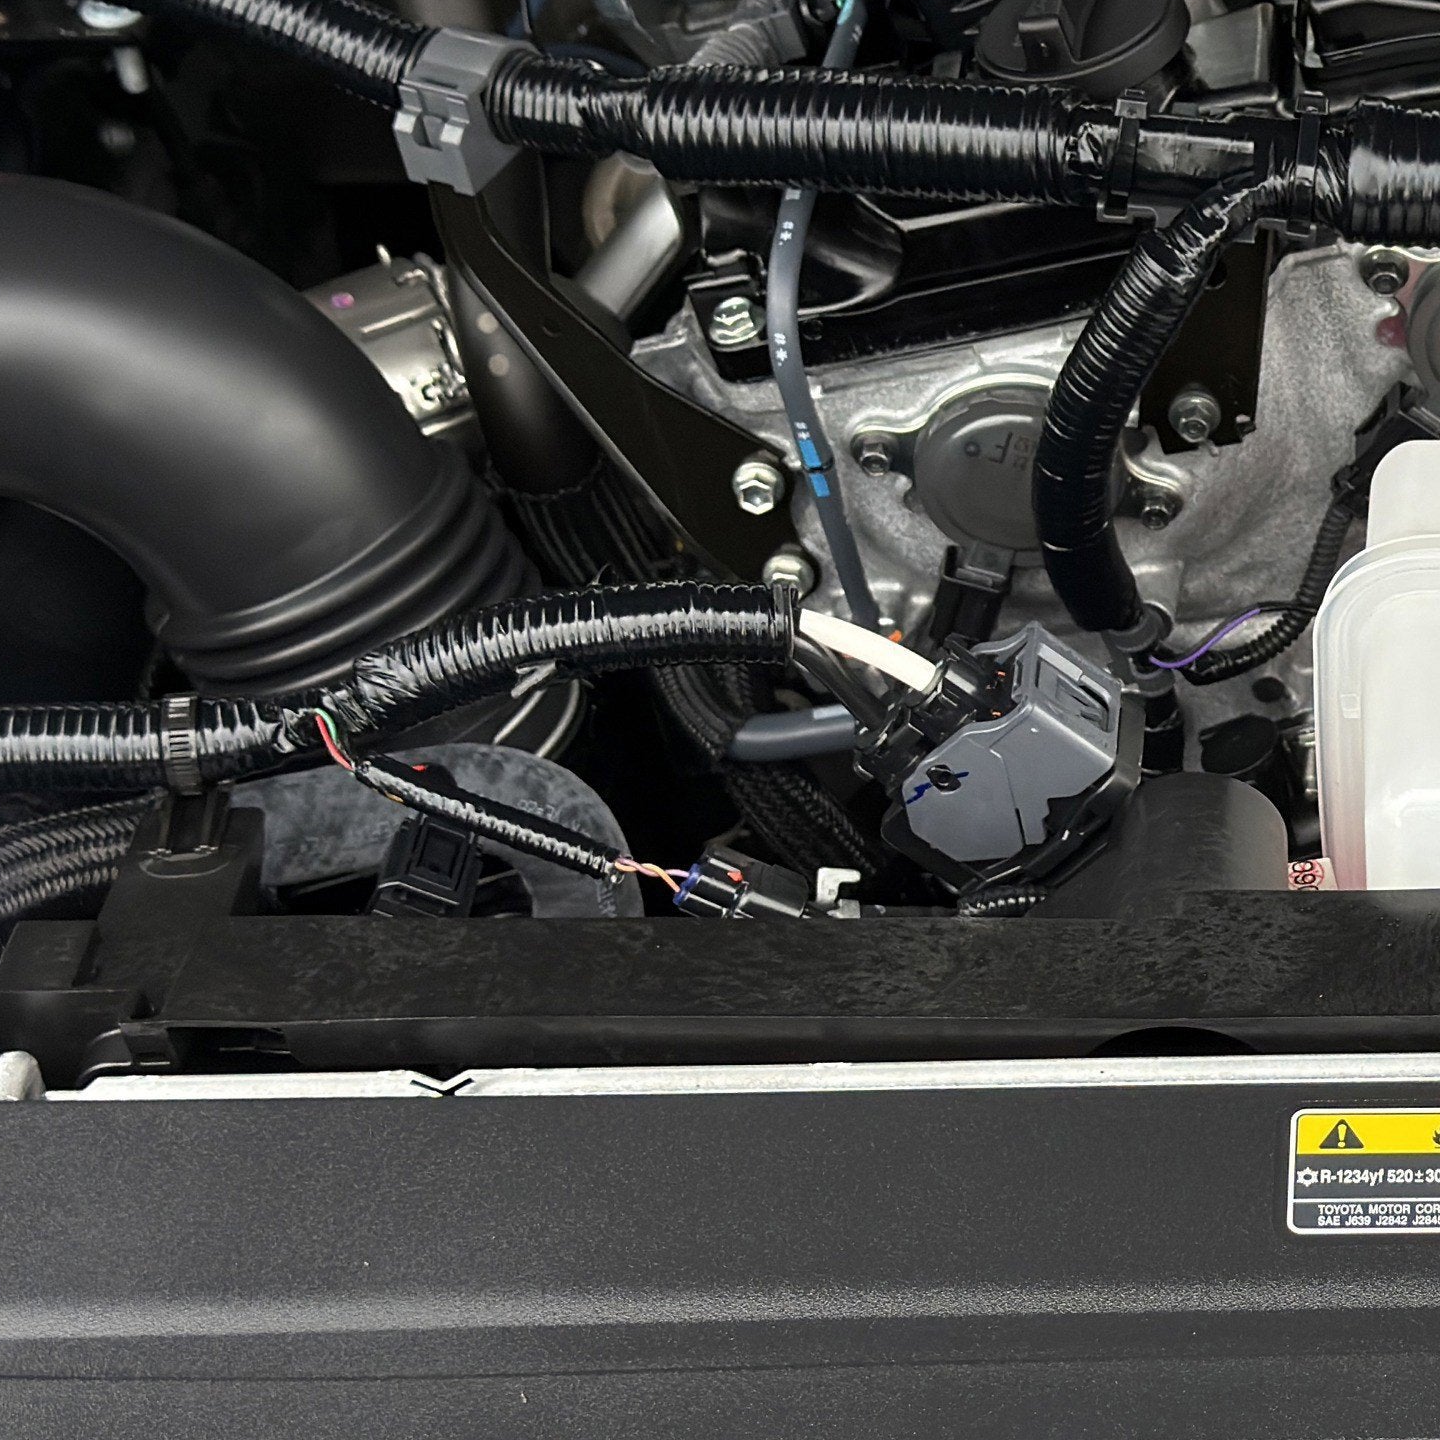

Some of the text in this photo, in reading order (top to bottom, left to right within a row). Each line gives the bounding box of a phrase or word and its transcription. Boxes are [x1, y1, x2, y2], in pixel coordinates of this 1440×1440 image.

[1320, 1168, 1385, 1186] R-1234yf
[1317, 1204, 1364, 1215] TOYOTA
[1368, 1203, 1411, 1215] MOTOR
[1317, 1216, 1341, 1226] SAE
[1345, 1215, 1371, 1226] J639
[1376, 1215, 1408, 1226] J2842
